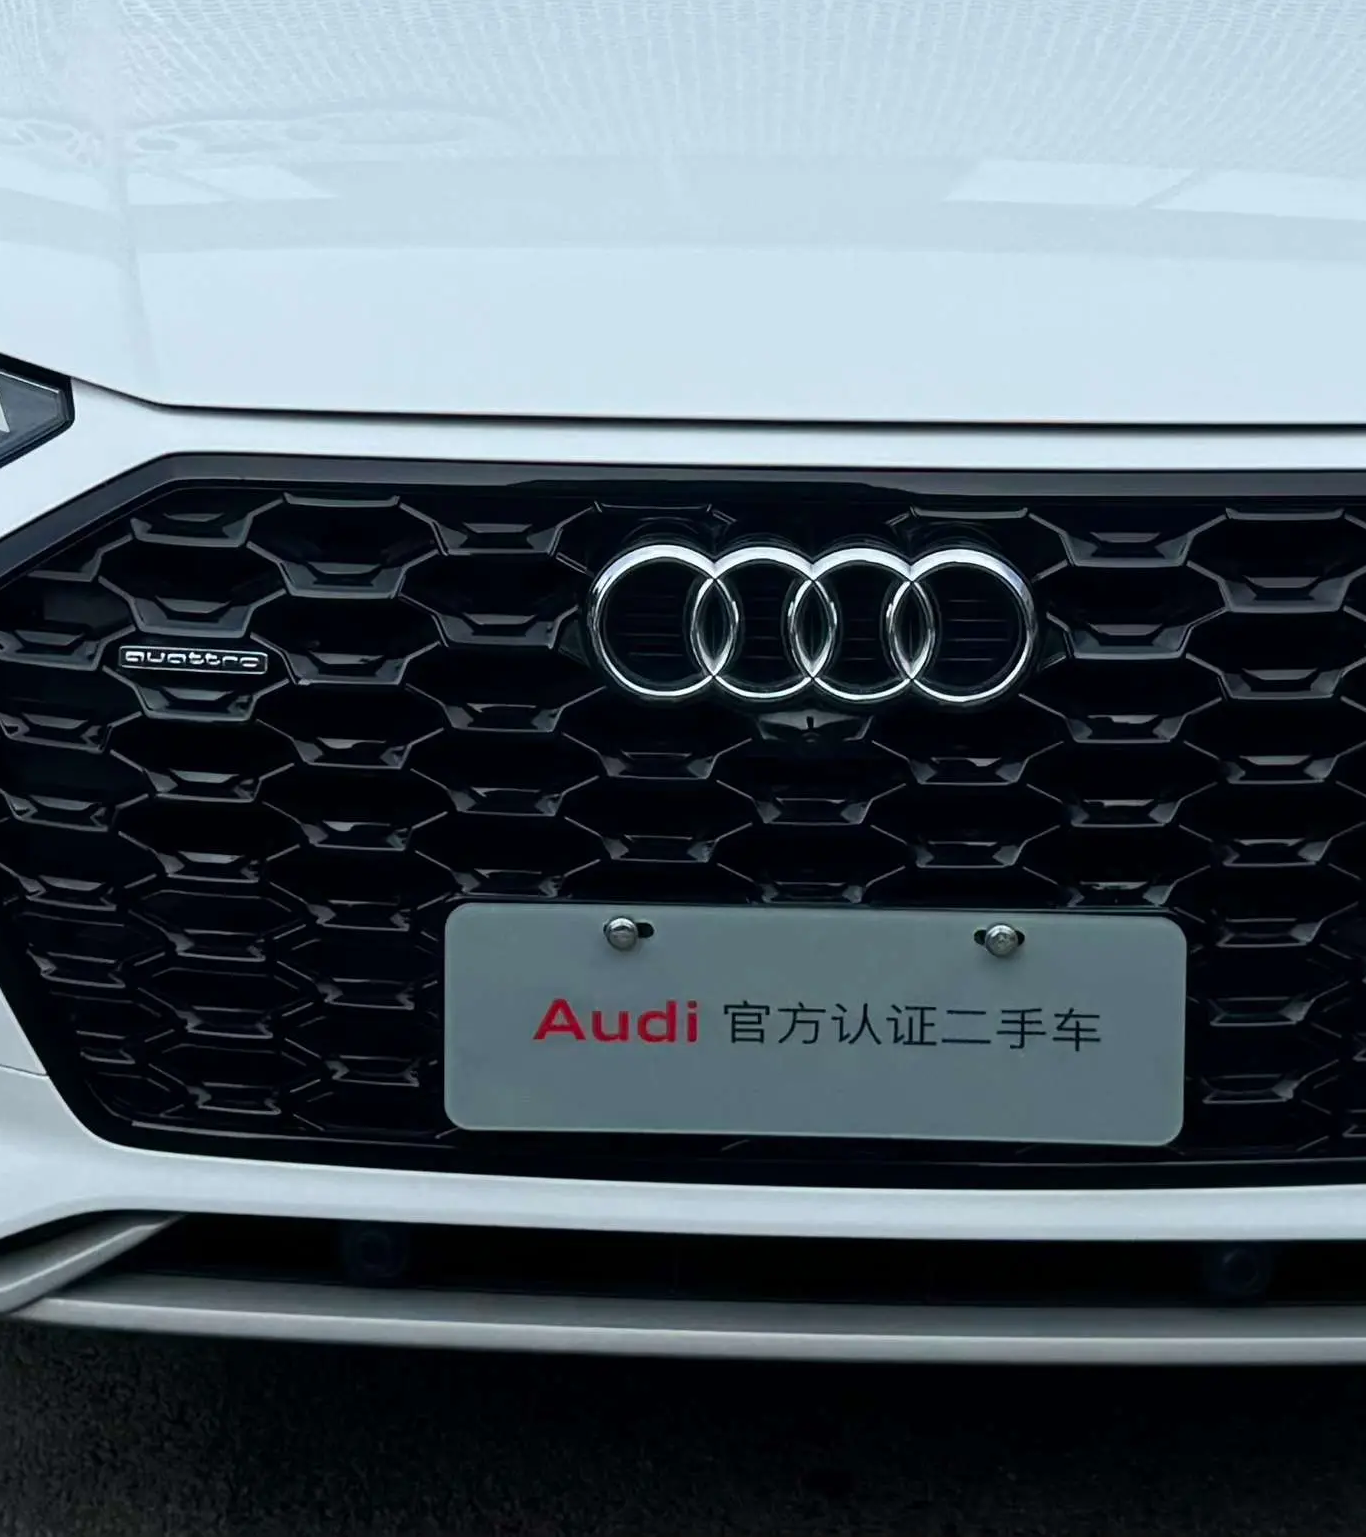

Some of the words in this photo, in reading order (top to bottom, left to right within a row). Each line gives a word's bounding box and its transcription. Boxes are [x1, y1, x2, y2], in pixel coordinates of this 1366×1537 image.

[534, 998, 698, 1043] Audi
[723, 1000, 1102, 1053] 官方认证二手车
